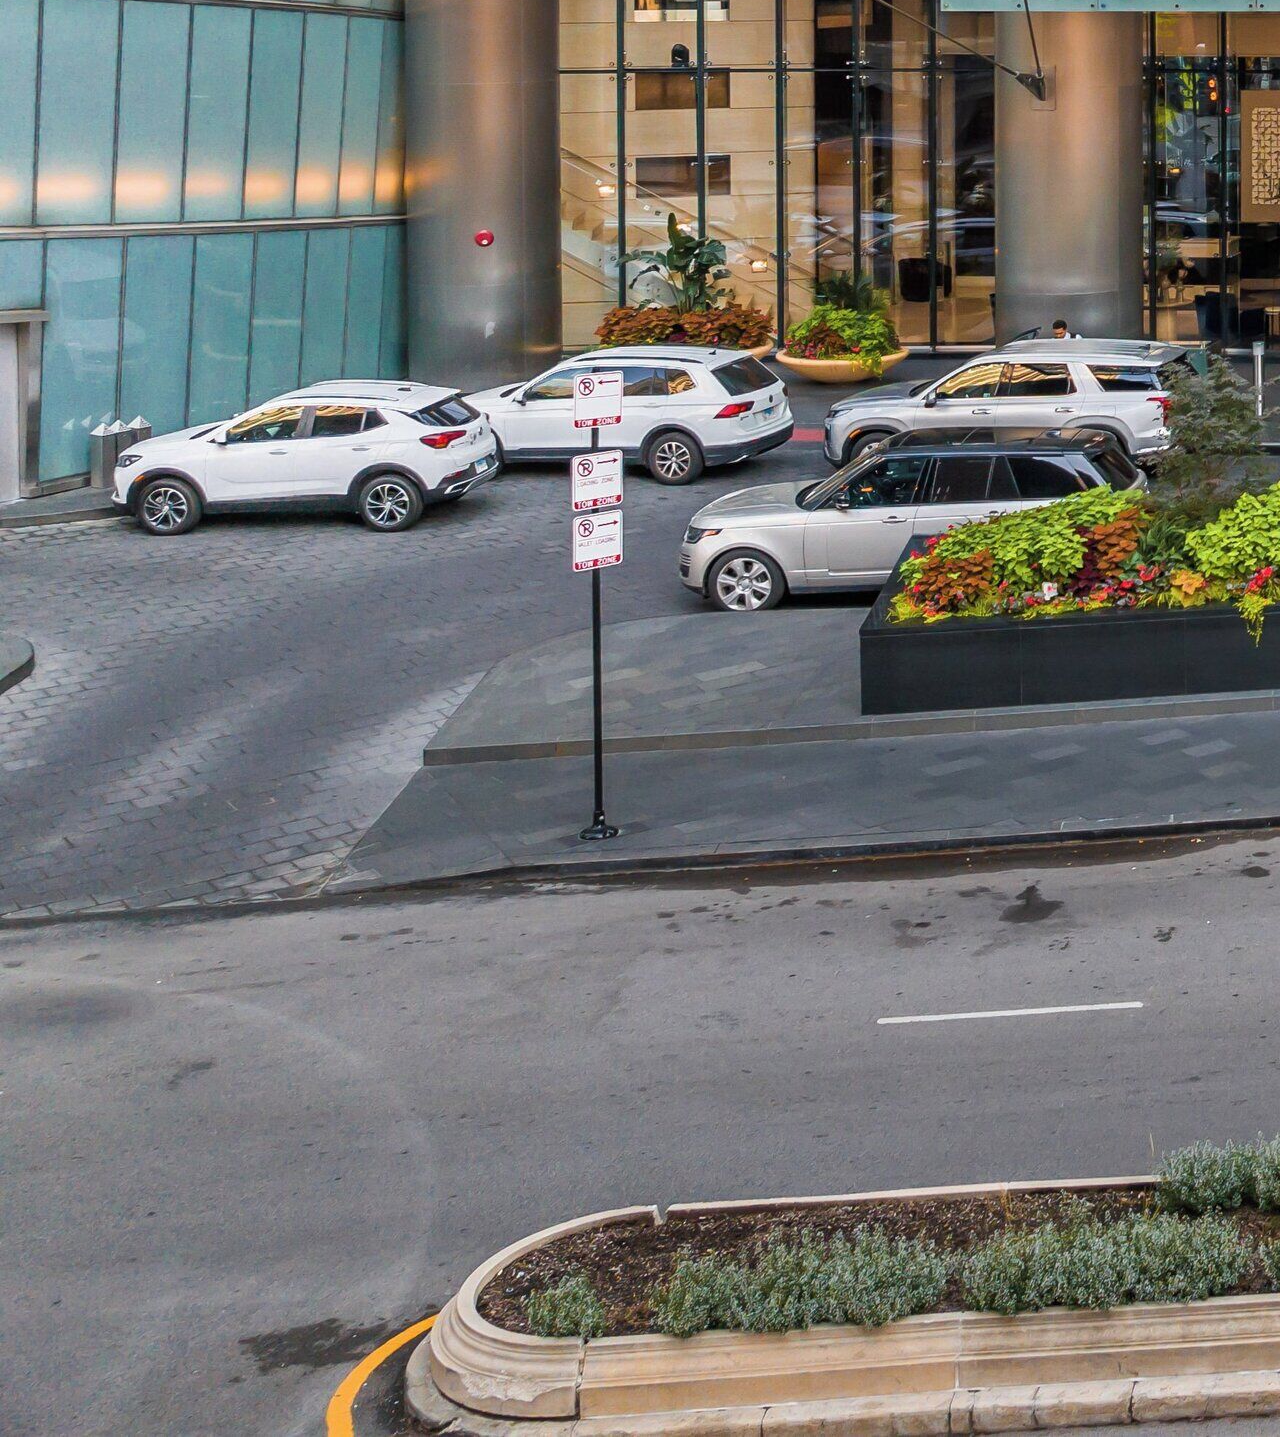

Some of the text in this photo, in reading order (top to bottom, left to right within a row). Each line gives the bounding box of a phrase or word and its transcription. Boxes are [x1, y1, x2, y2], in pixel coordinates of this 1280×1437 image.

[577, 417, 617, 427] TOW ZONE
[577, 477, 615, 487] LOADING ZONE
[577, 496, 617, 509] TOW ZONE
[596, 536, 616, 545] LOADING
[577, 556, 617, 570] TOW ZONE
